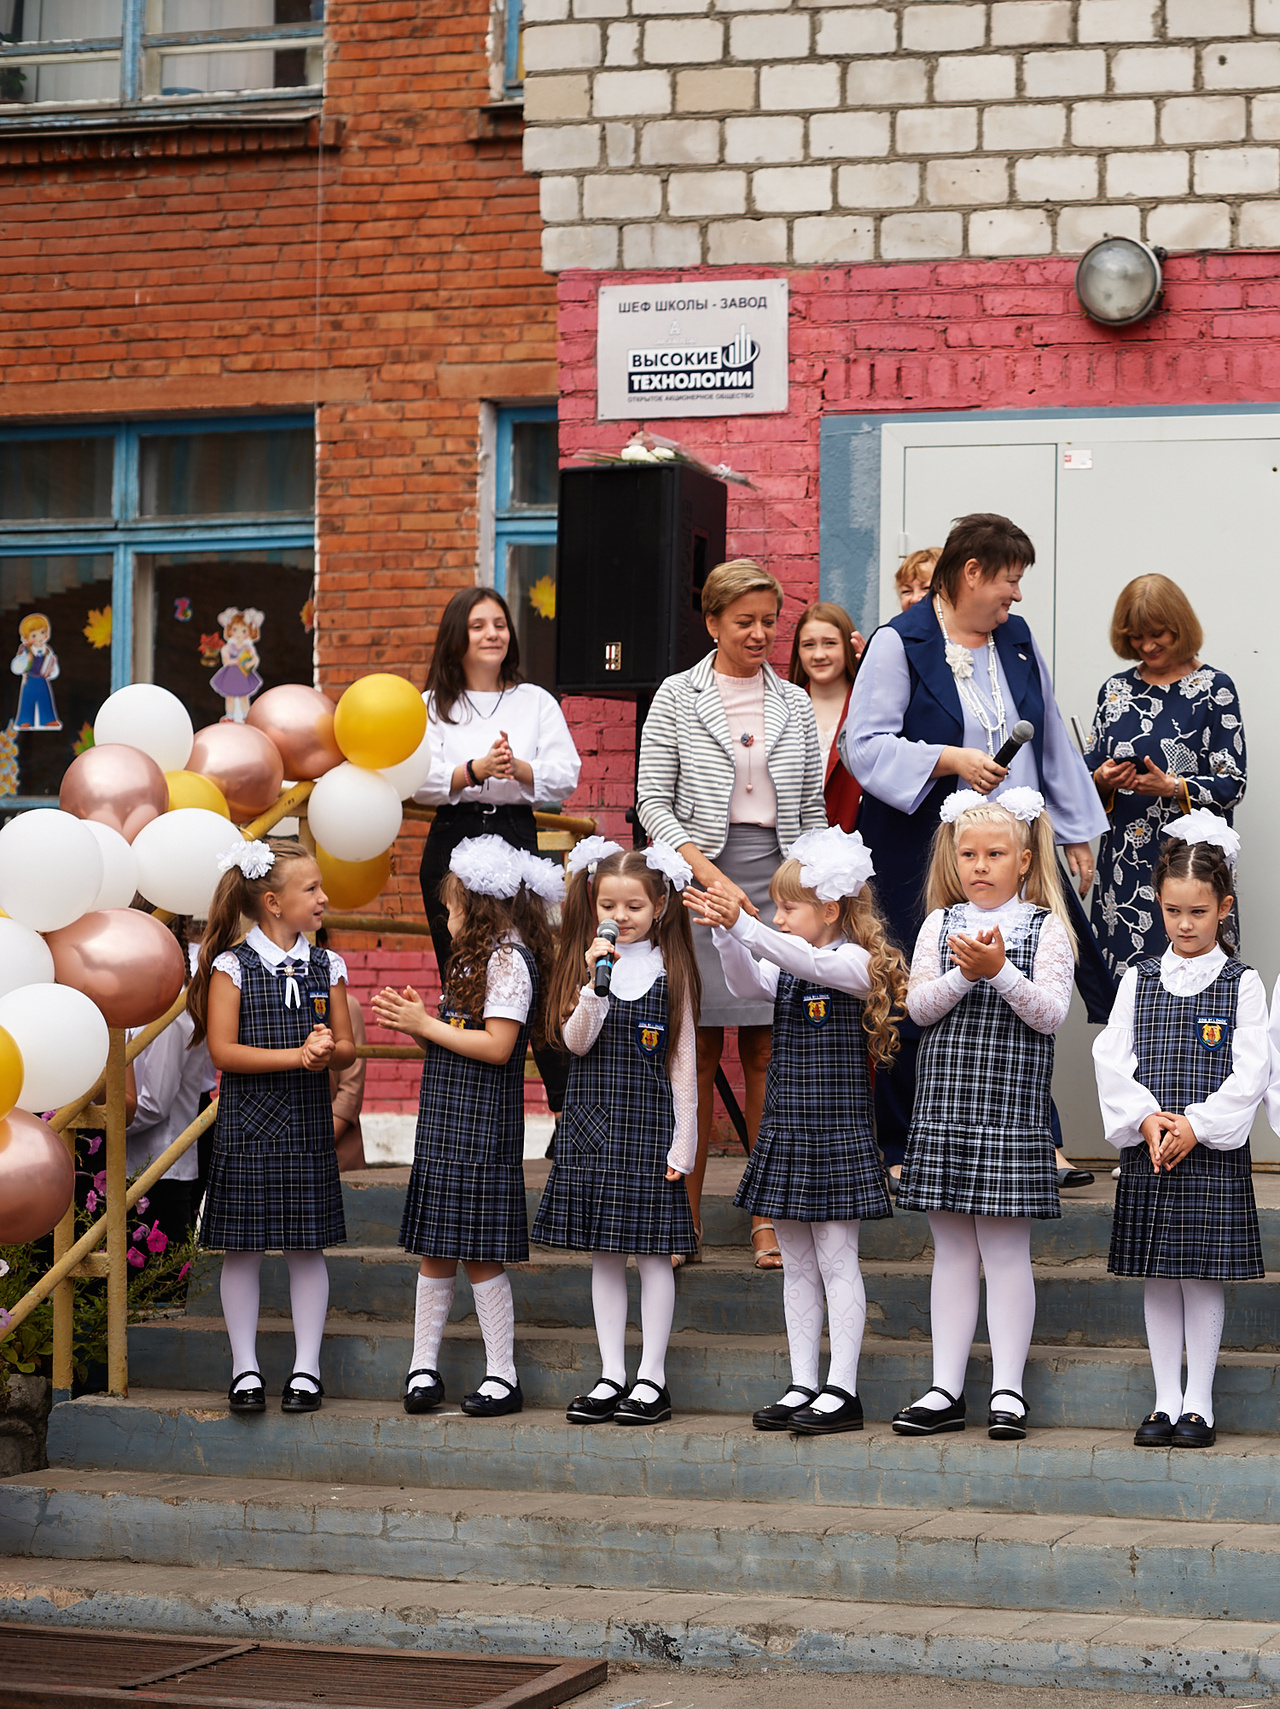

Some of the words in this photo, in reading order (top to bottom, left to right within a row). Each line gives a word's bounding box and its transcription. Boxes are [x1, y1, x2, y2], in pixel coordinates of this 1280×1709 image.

[619, 302, 651, 313] ШЕФ
[656, 299, 707, 311] ШКОЛЫ
[721, 297, 767, 309] ЗАВОД
[633, 352, 717, 367] ВЫСОКИЕ
[631, 371, 752, 390] ТЕХНОЛОГИИ
[665, 393, 713, 401] АКЦИОНЕРНОЕ
